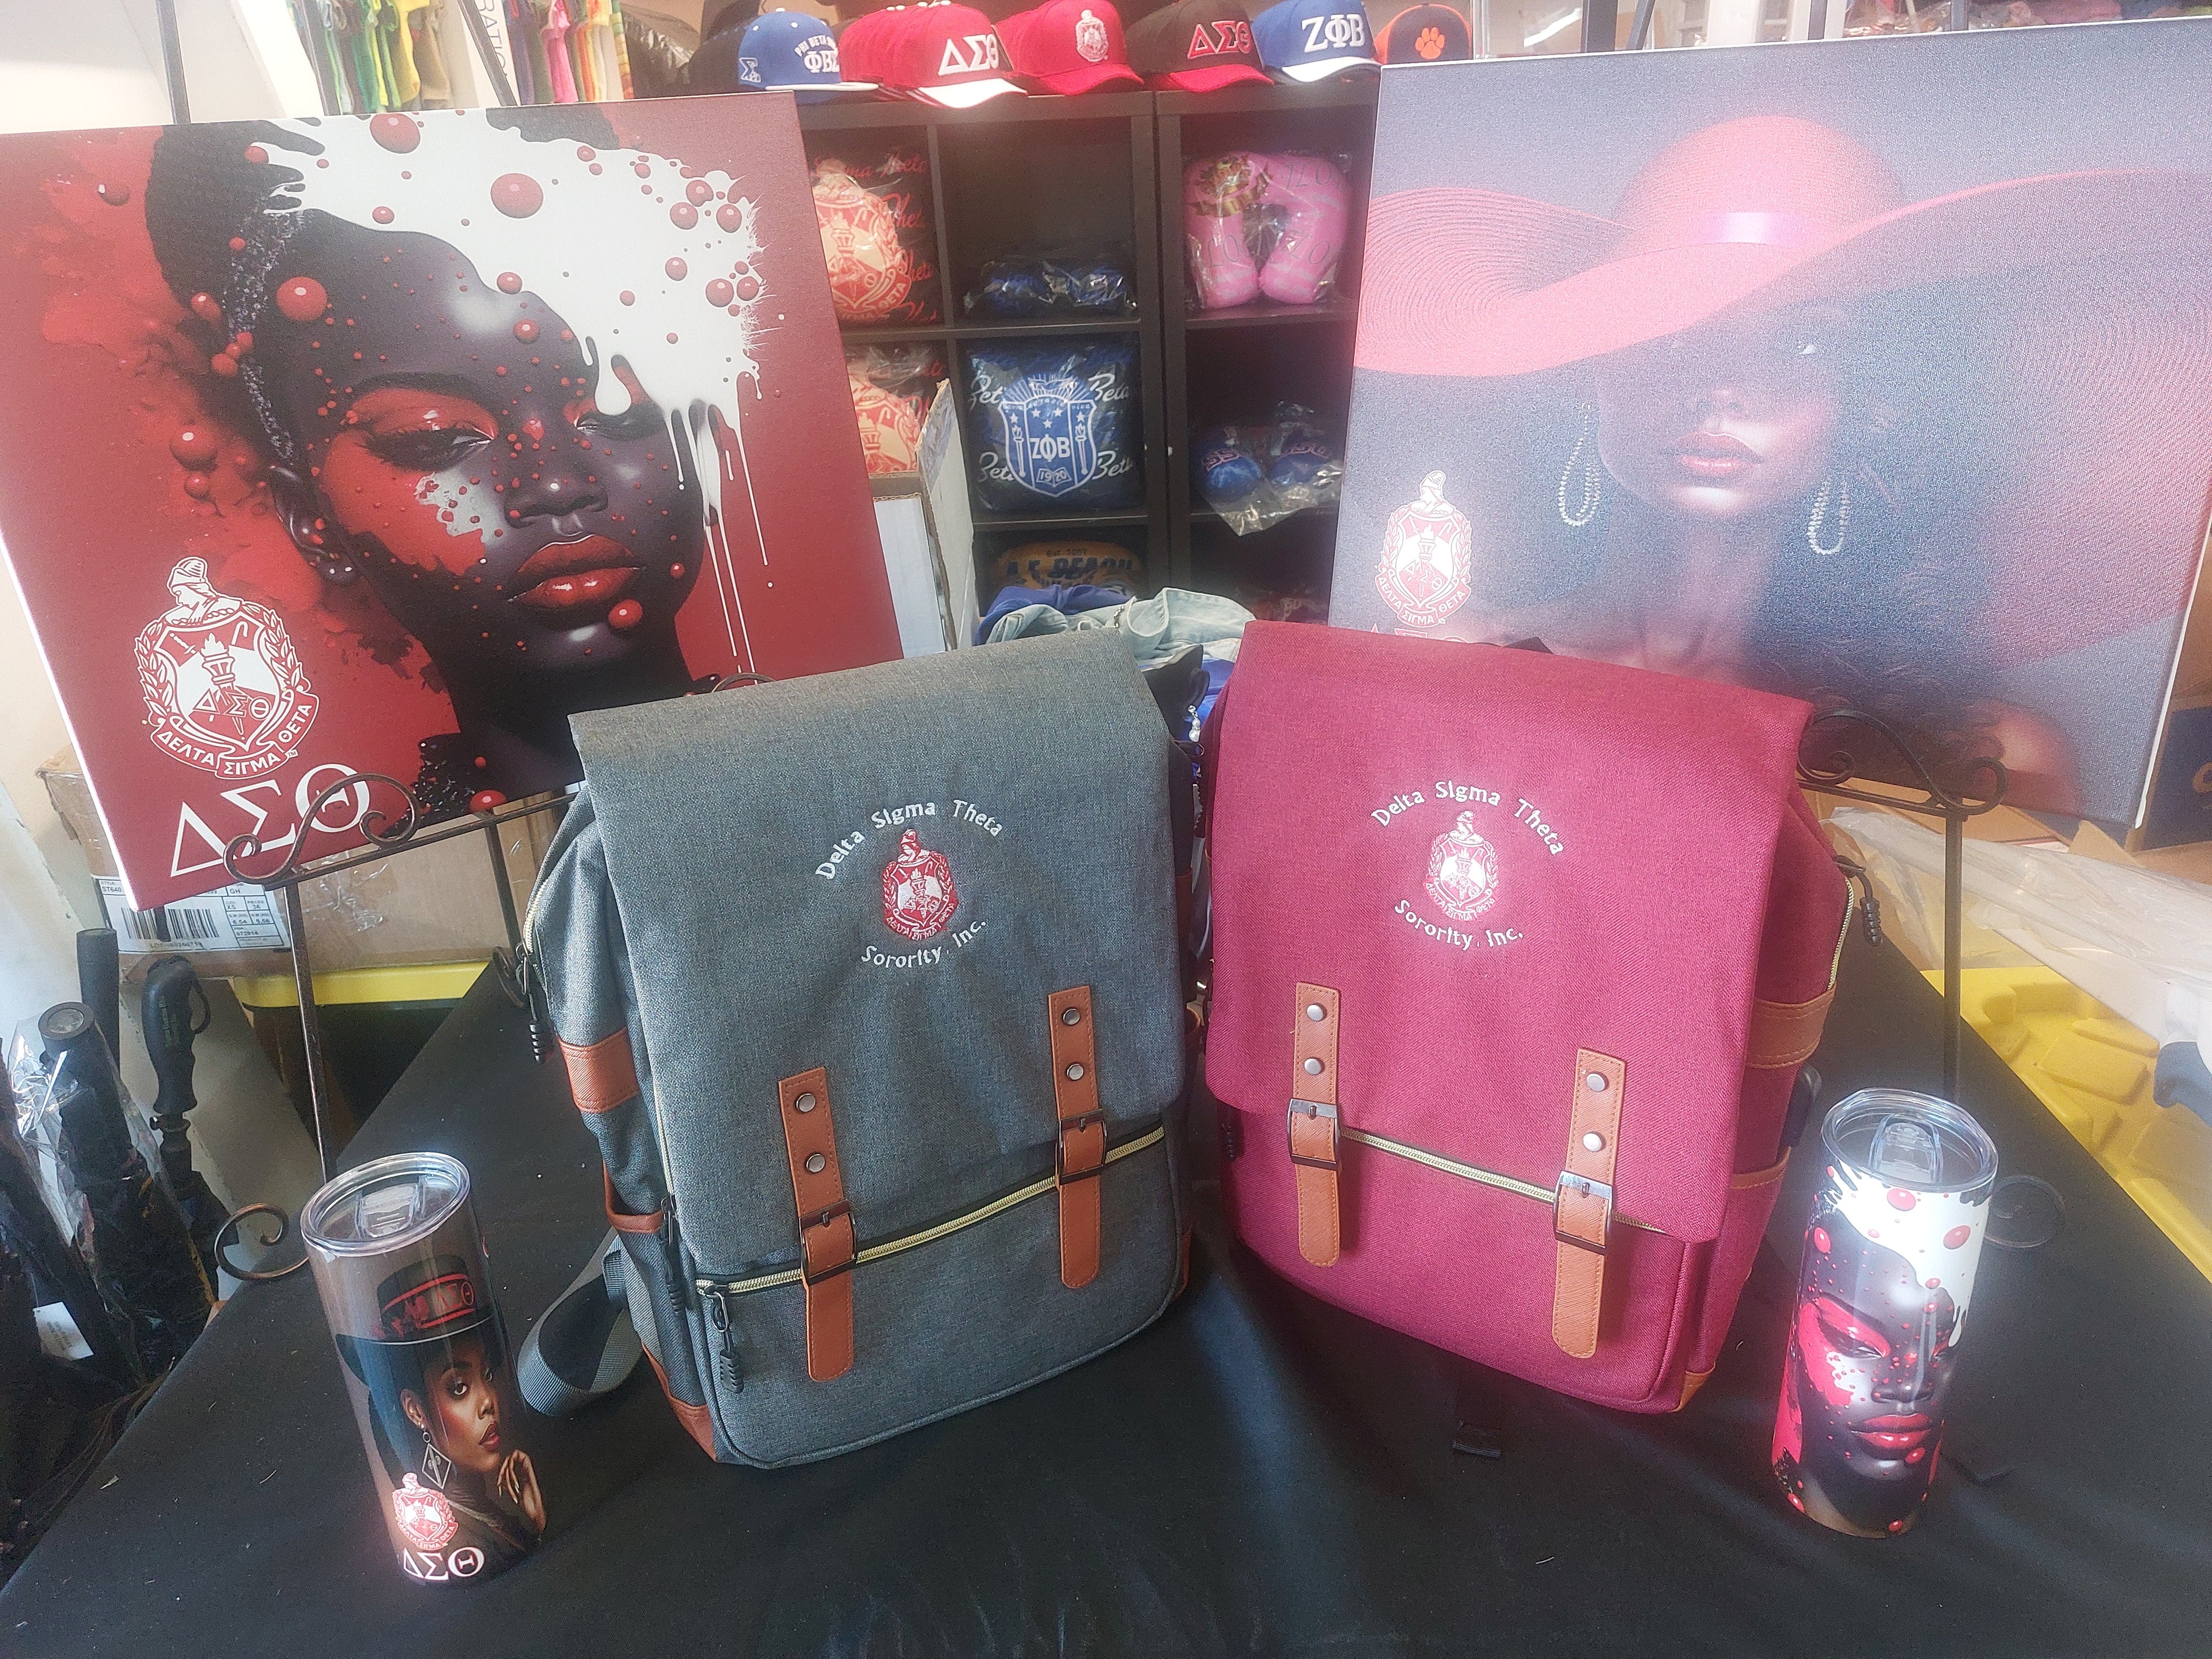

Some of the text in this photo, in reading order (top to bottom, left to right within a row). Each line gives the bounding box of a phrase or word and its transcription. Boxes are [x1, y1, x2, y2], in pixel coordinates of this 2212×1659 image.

[938, 33, 999, 76] ΔΣΘ
[1187, 20, 1252, 59] ΔΣΘ
[1378, 577, 1466, 625] ΔΕΛΤΑ ΣΙΓΜΑ ΘΕΤΑ
[157, 704, 312, 775] ΔΕΛΤΑ ΣΙΓΜΑ ΘΕΤΑ
[171, 763, 370, 877] ΔΣΘ
[815, 799, 1003, 880] Delta Sigma Theta
[1371, 780, 1564, 855] Delta Sigma Theta
[952, 919, 986, 948] Inc.
[1484, 927, 1524, 948] Inc.
[403, 1547, 485, 1580] ΔΣΘ
